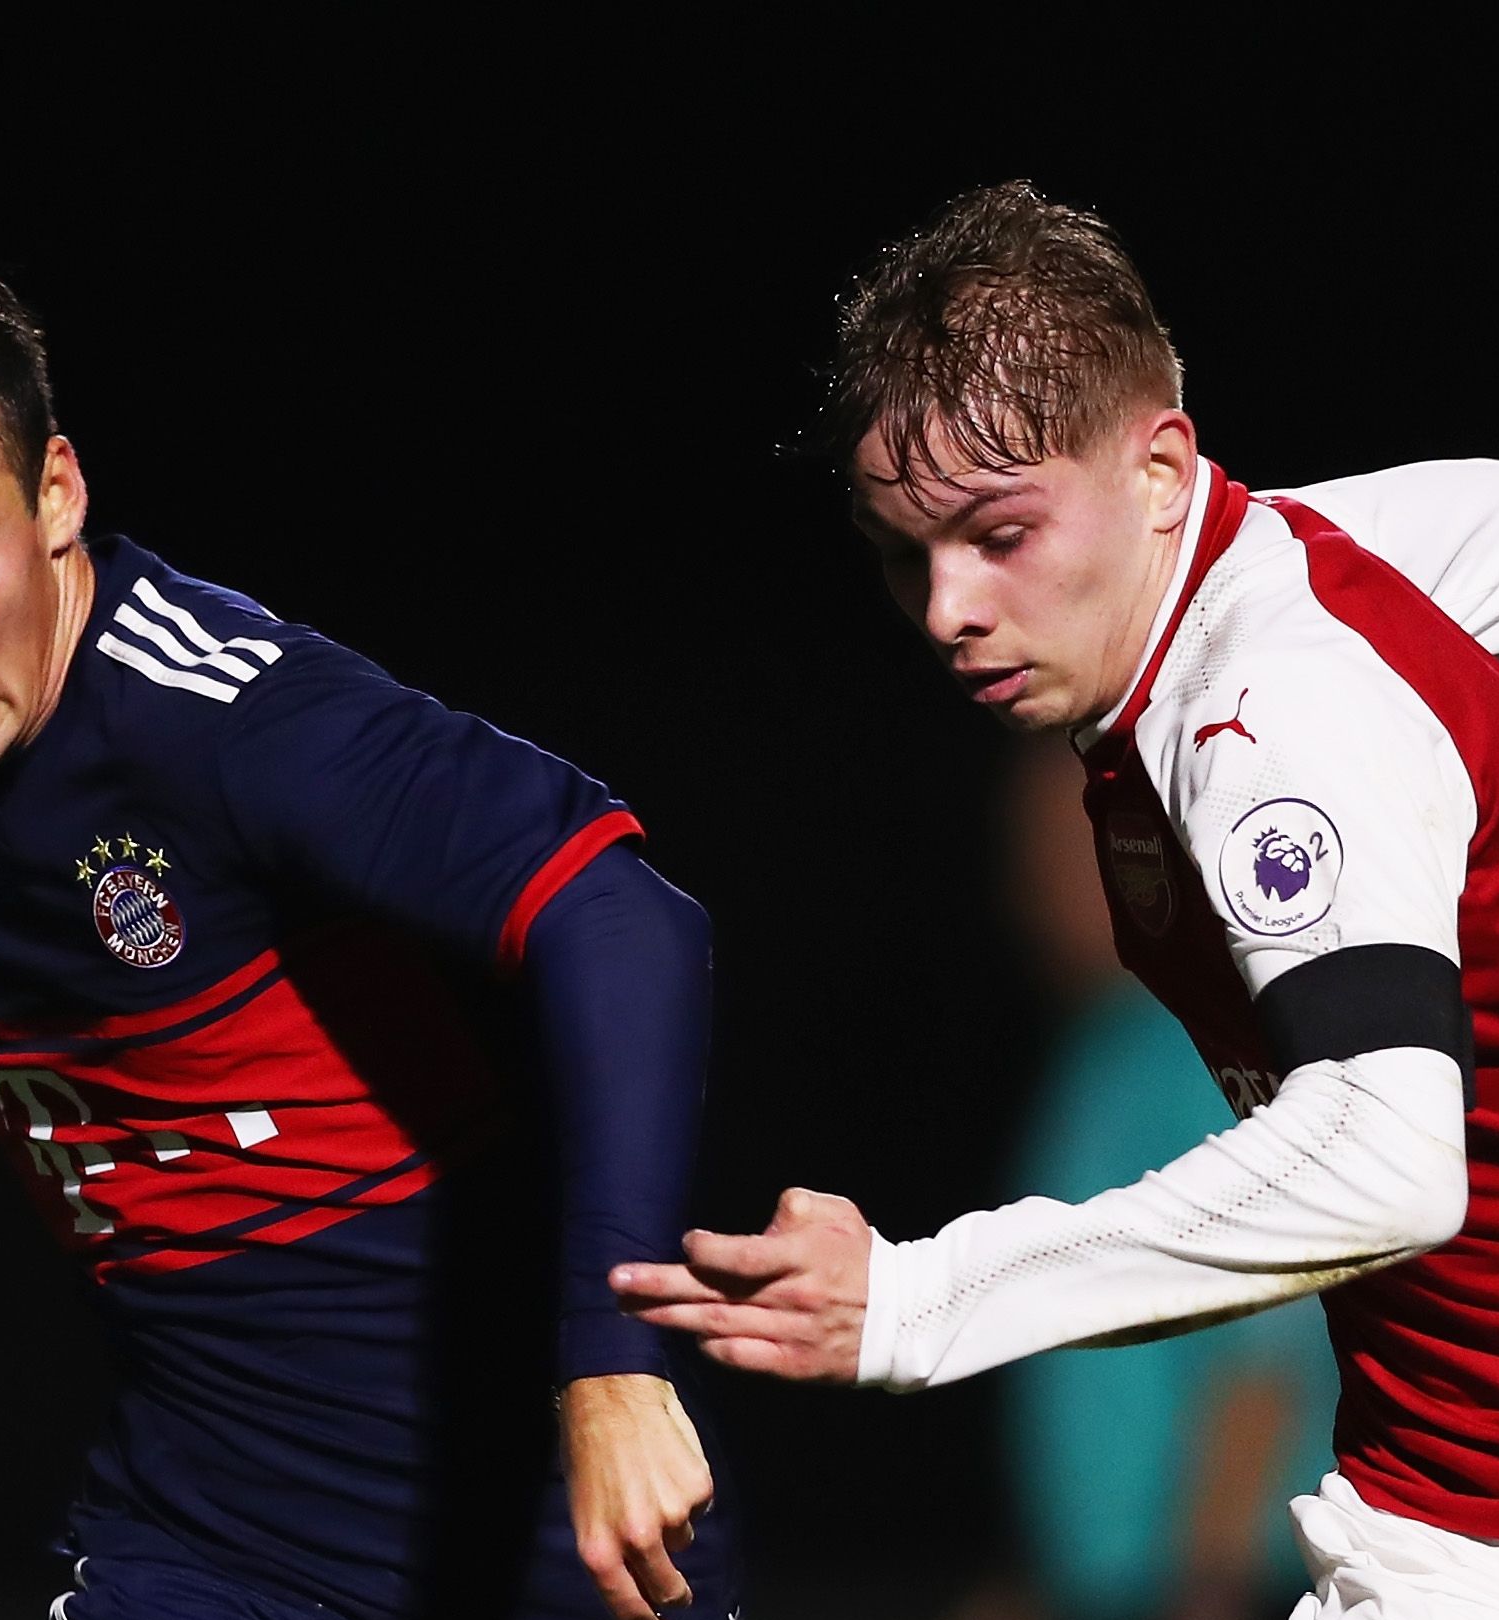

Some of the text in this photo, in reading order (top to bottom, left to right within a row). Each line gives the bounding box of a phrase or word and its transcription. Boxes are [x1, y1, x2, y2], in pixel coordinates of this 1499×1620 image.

[1309, 831, 1329, 862] 2
[97, 874, 169, 918] FC BAYERN
[1265, 911, 1305, 928] League
